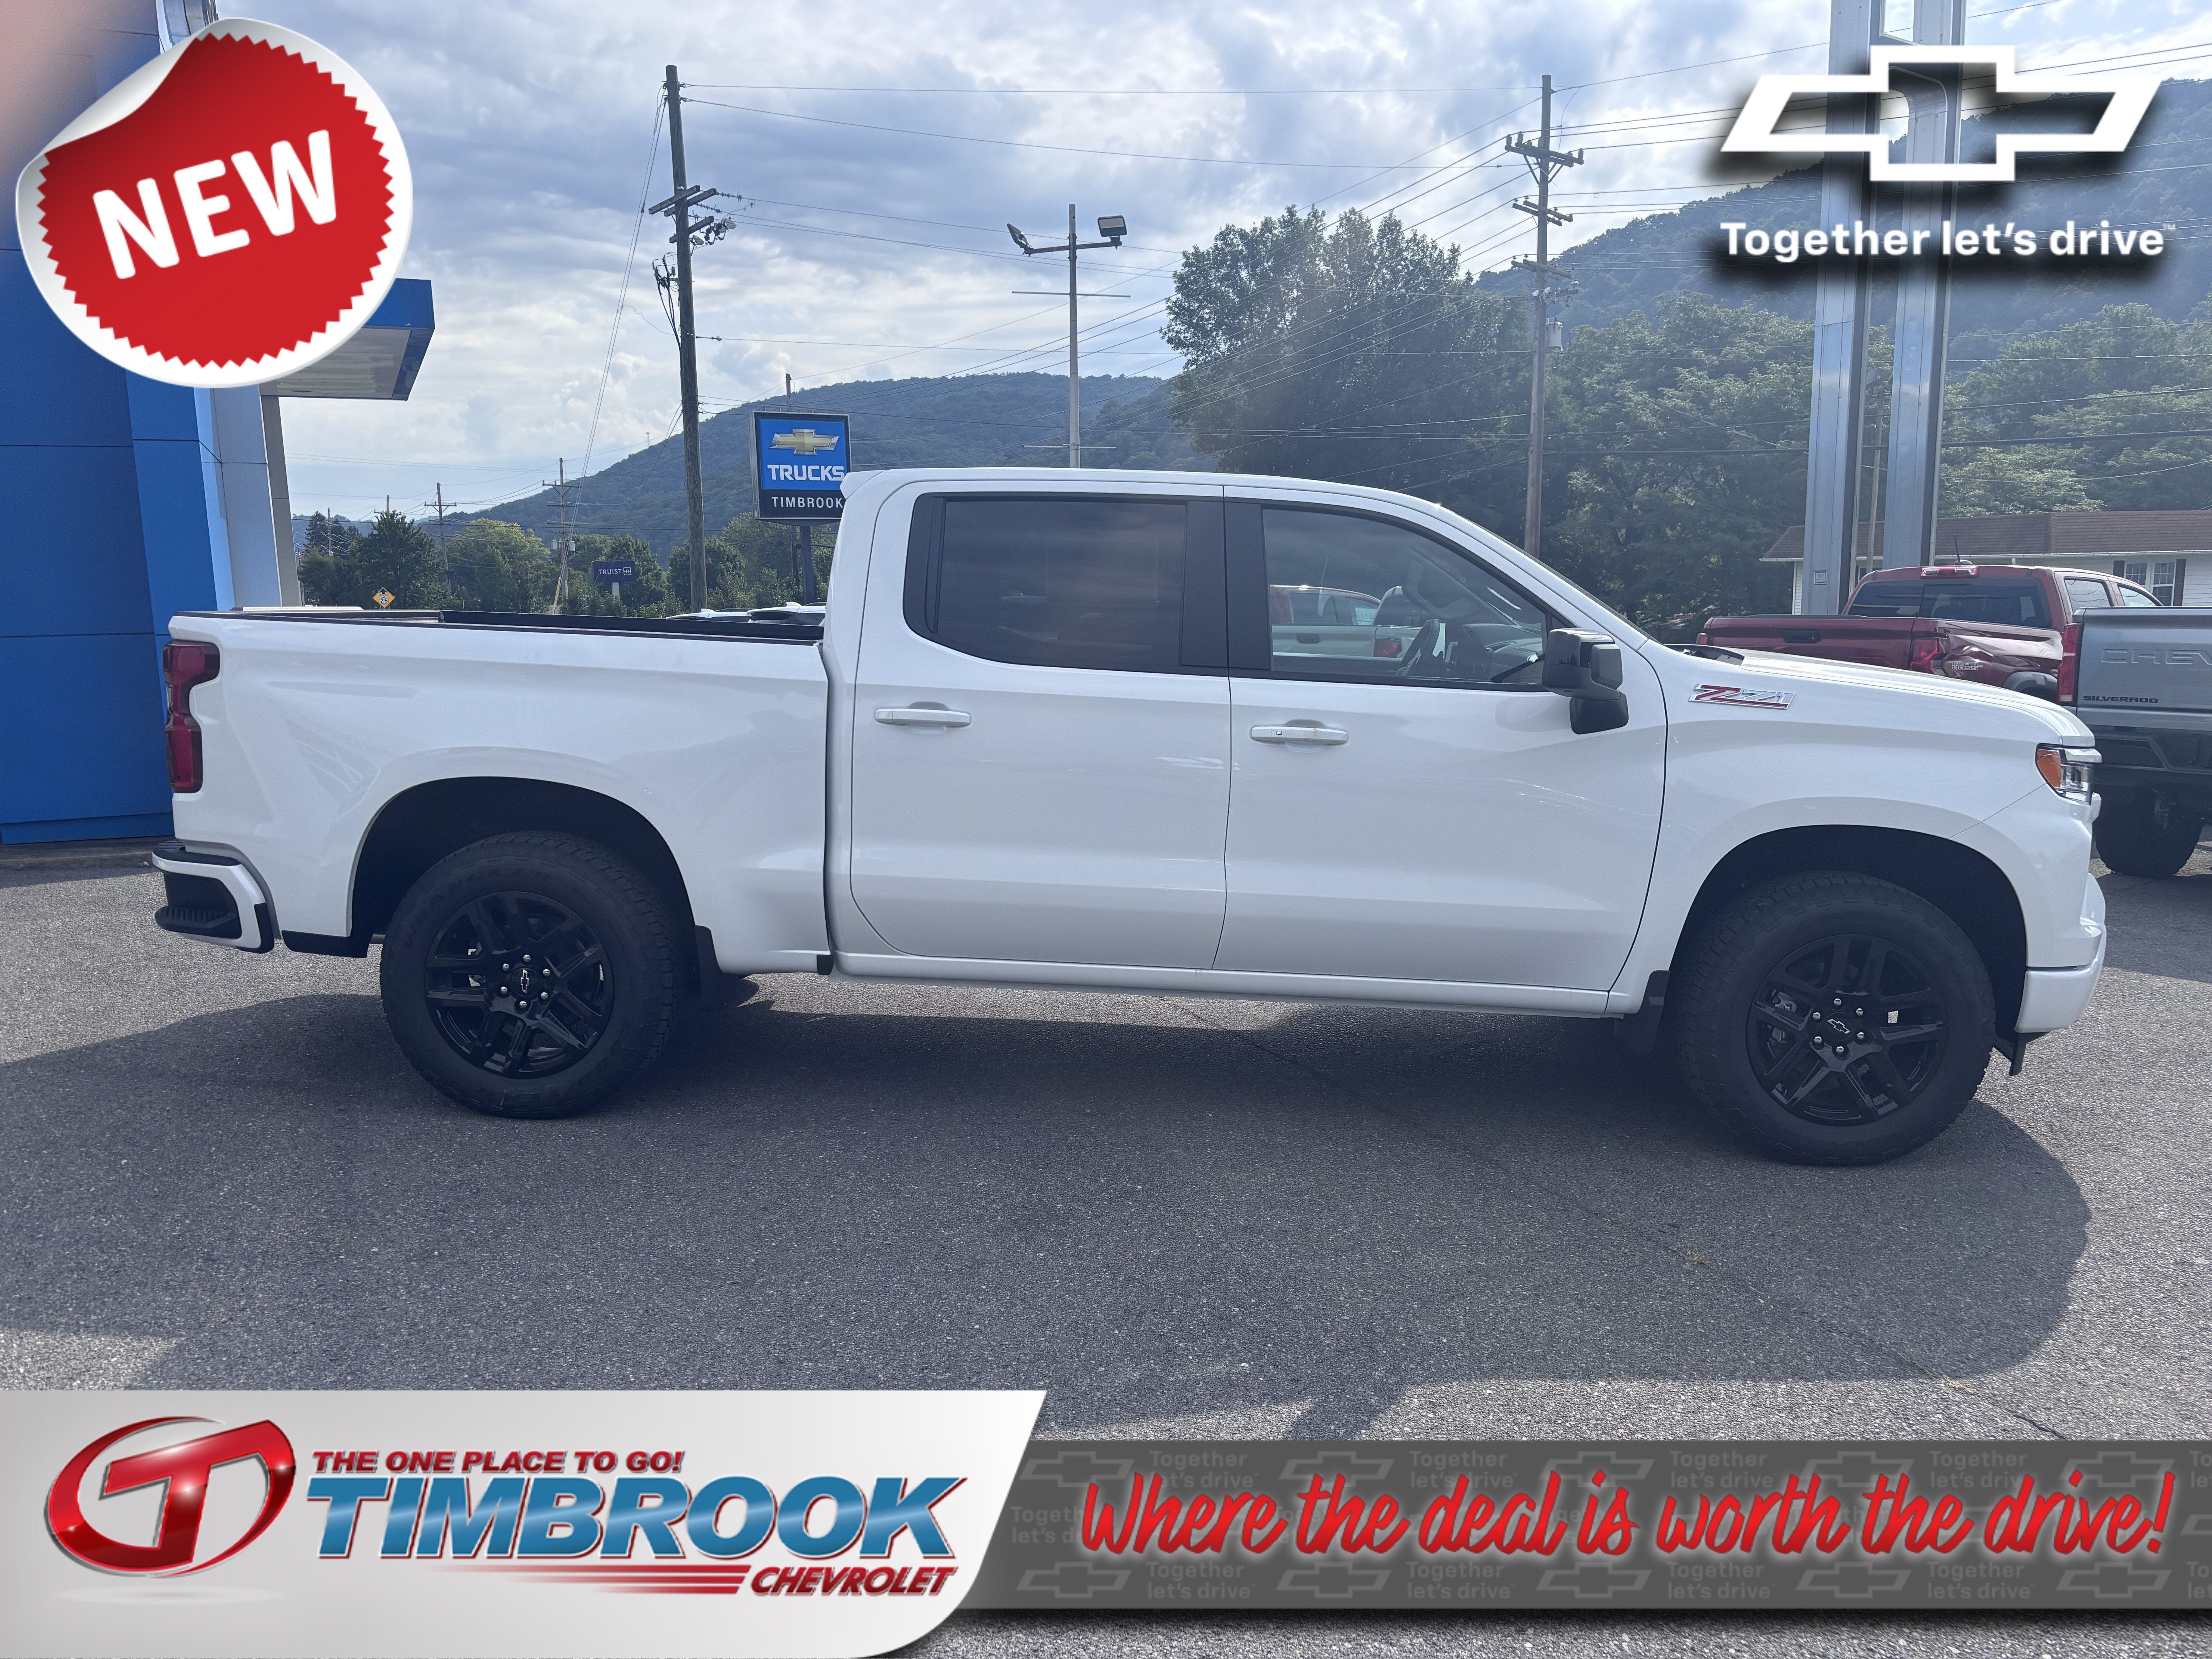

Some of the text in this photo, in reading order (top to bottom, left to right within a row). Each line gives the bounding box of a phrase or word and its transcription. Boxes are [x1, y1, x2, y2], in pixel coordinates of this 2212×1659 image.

[767, 464, 845, 481] TRUCKS
[771, 496, 843, 508] TIMBROOK
[1688, 684, 1795, 710] Z71
[2083, 695, 2158, 704] SILVERADO
